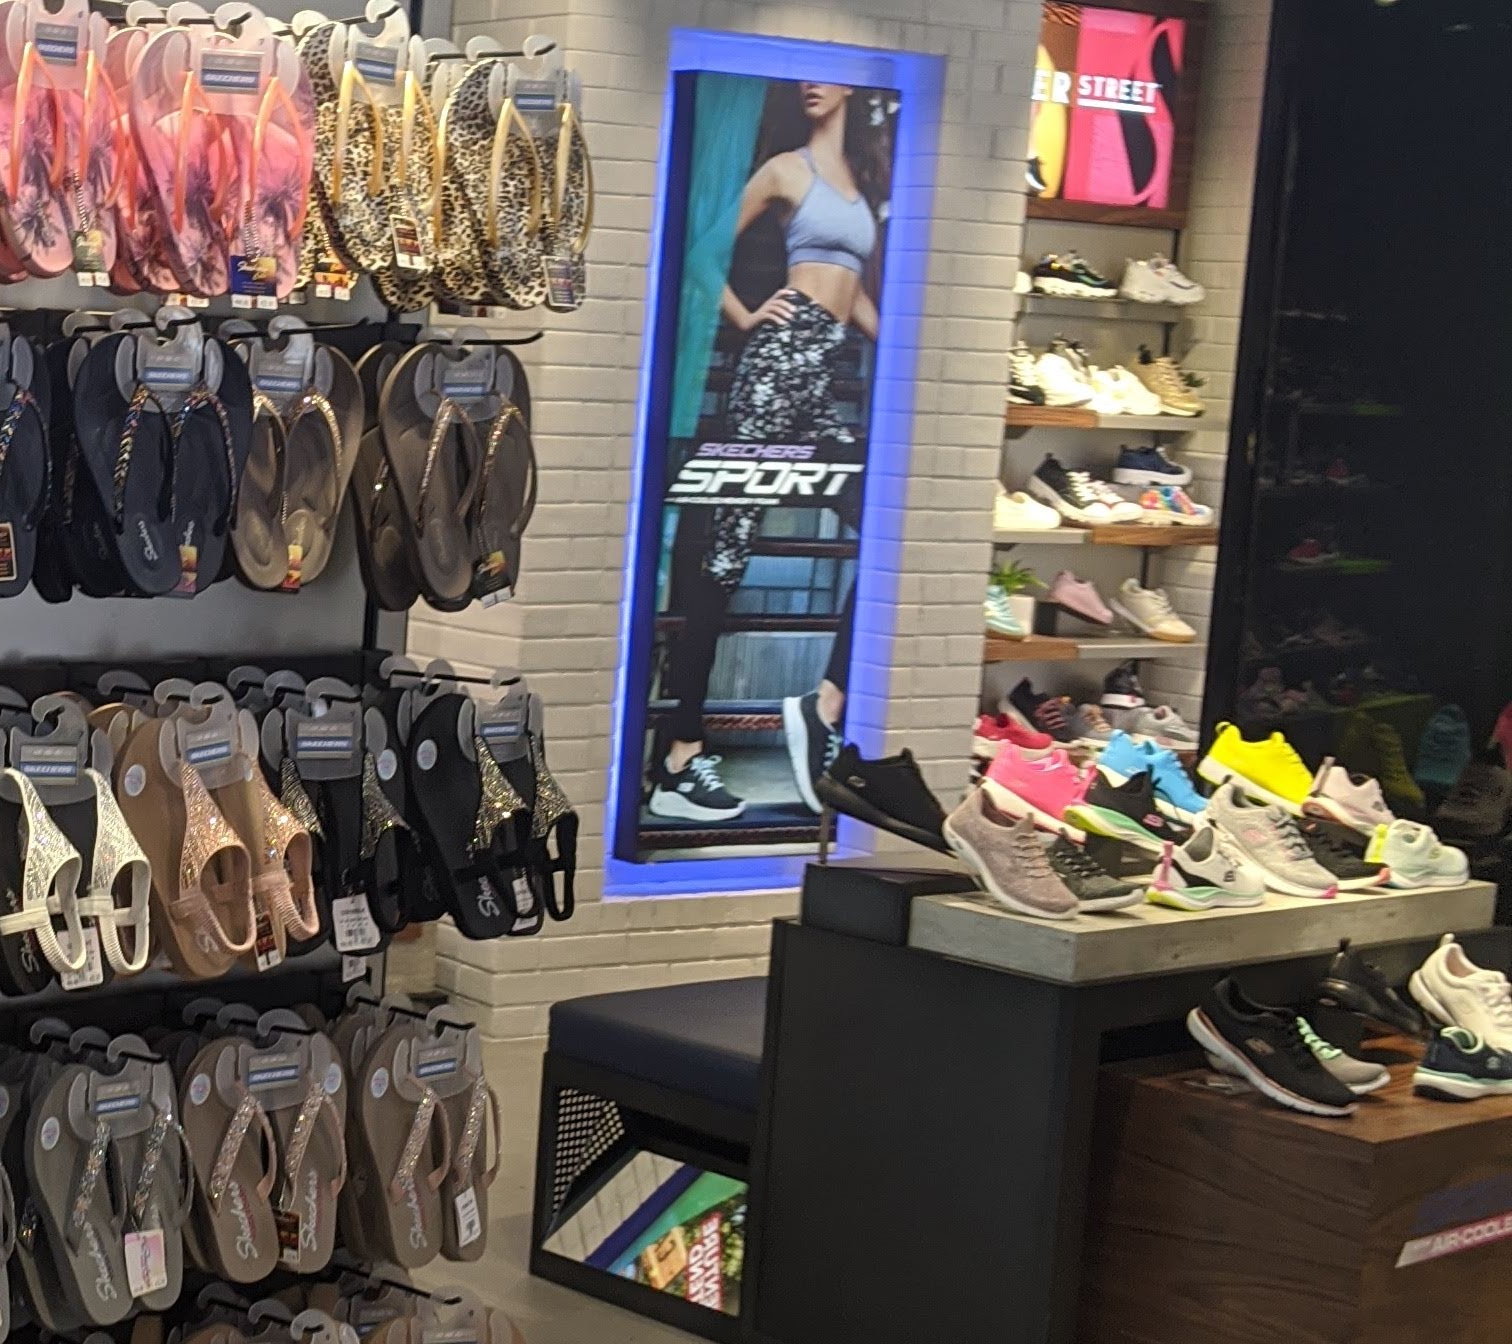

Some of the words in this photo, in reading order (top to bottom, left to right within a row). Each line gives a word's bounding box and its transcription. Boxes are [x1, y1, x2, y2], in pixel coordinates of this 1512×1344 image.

[1077, 75, 1161, 104] STREET
[695, 442, 817, 460] SKECHERS
[668, 460, 865, 496] SPORT
